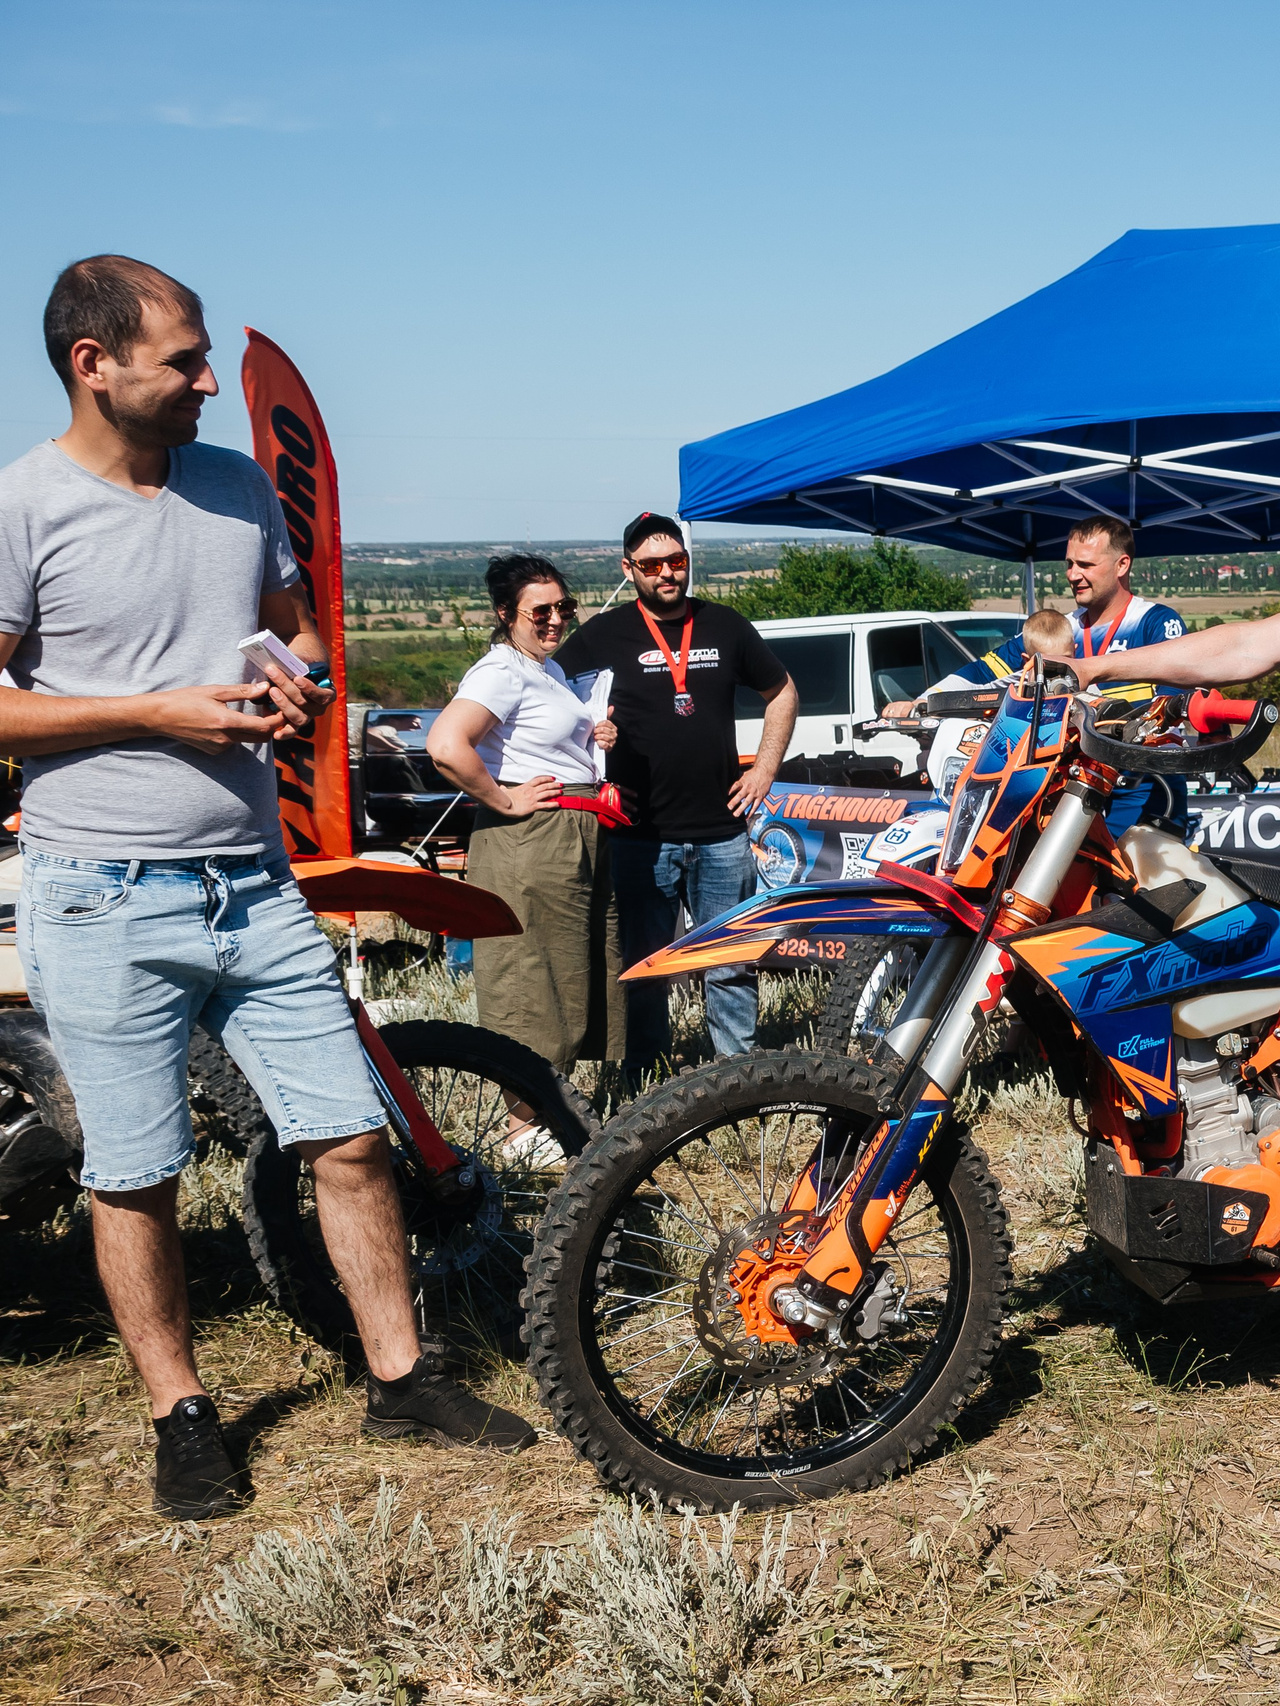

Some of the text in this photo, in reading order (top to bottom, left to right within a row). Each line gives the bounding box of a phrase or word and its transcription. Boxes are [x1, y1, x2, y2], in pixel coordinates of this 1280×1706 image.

[782, 793, 908, 824] TAGENDURO
[1139, 1037, 1154, 1045] FULL
[1139, 1038, 1165, 1051] EXTREME
[918, 1112, 943, 1164] K10
